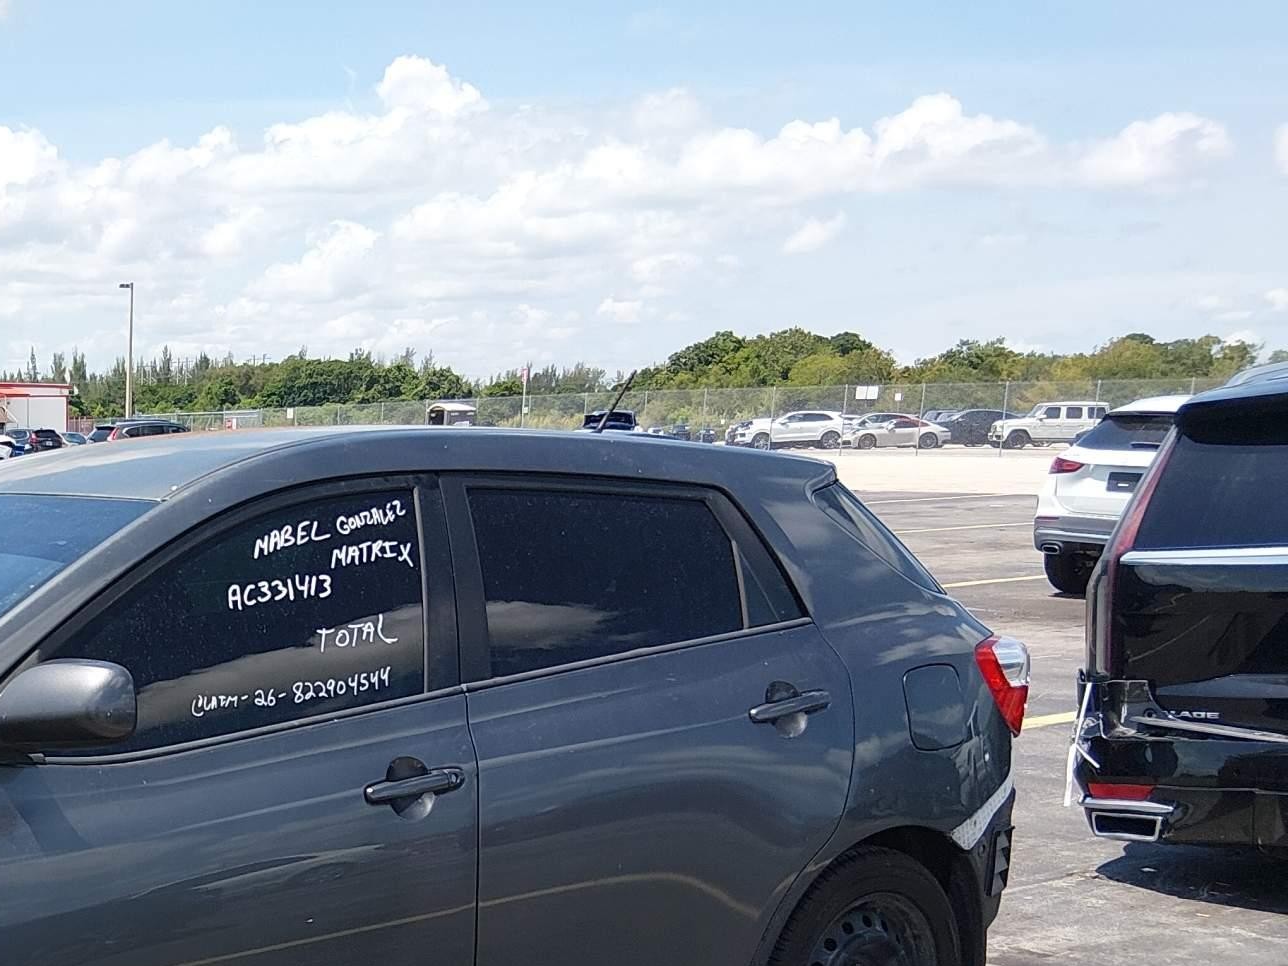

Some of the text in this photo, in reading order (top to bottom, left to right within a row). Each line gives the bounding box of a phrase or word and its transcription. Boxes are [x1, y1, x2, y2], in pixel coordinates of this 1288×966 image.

[253, 520, 331, 559] MABEL
[330, 539, 414, 569] MATRIX
[227, 574, 332, 611] AC331413
[316, 613, 399, 652] TOTAL
